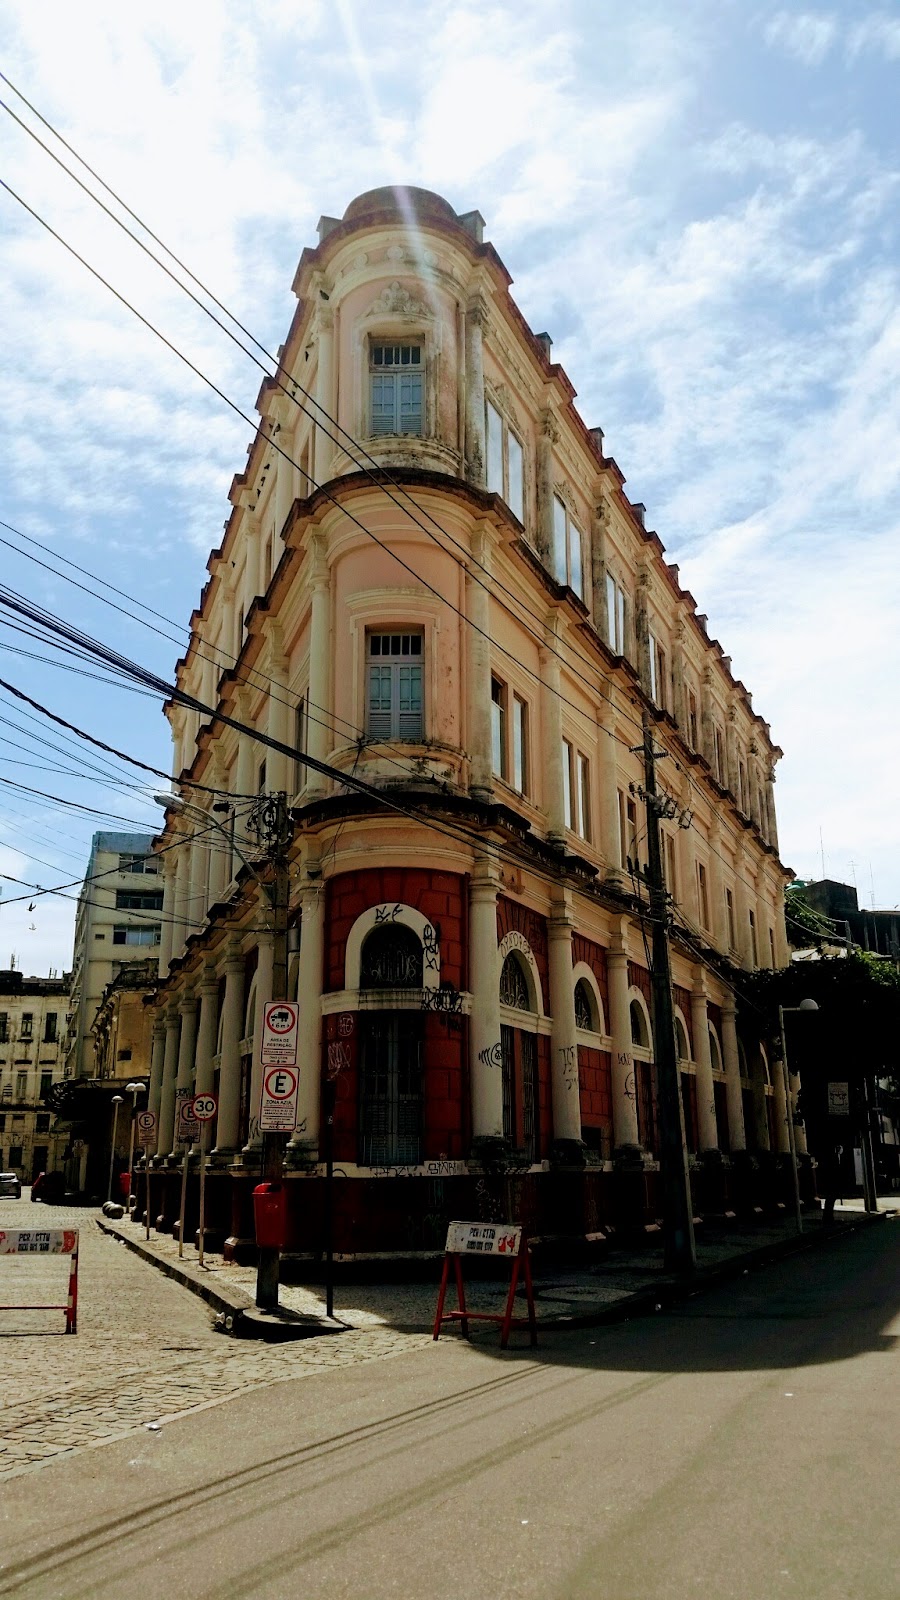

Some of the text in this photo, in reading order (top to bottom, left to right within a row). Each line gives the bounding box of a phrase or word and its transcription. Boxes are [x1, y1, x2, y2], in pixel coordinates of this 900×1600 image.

[275, 1076, 286, 1093] E
[187, 1106, 194, 1118] E
[195, 1101, 214, 1112] 30
[144, 1116, 150, 1126] E
[18, 1233, 31, 1242] PCR
